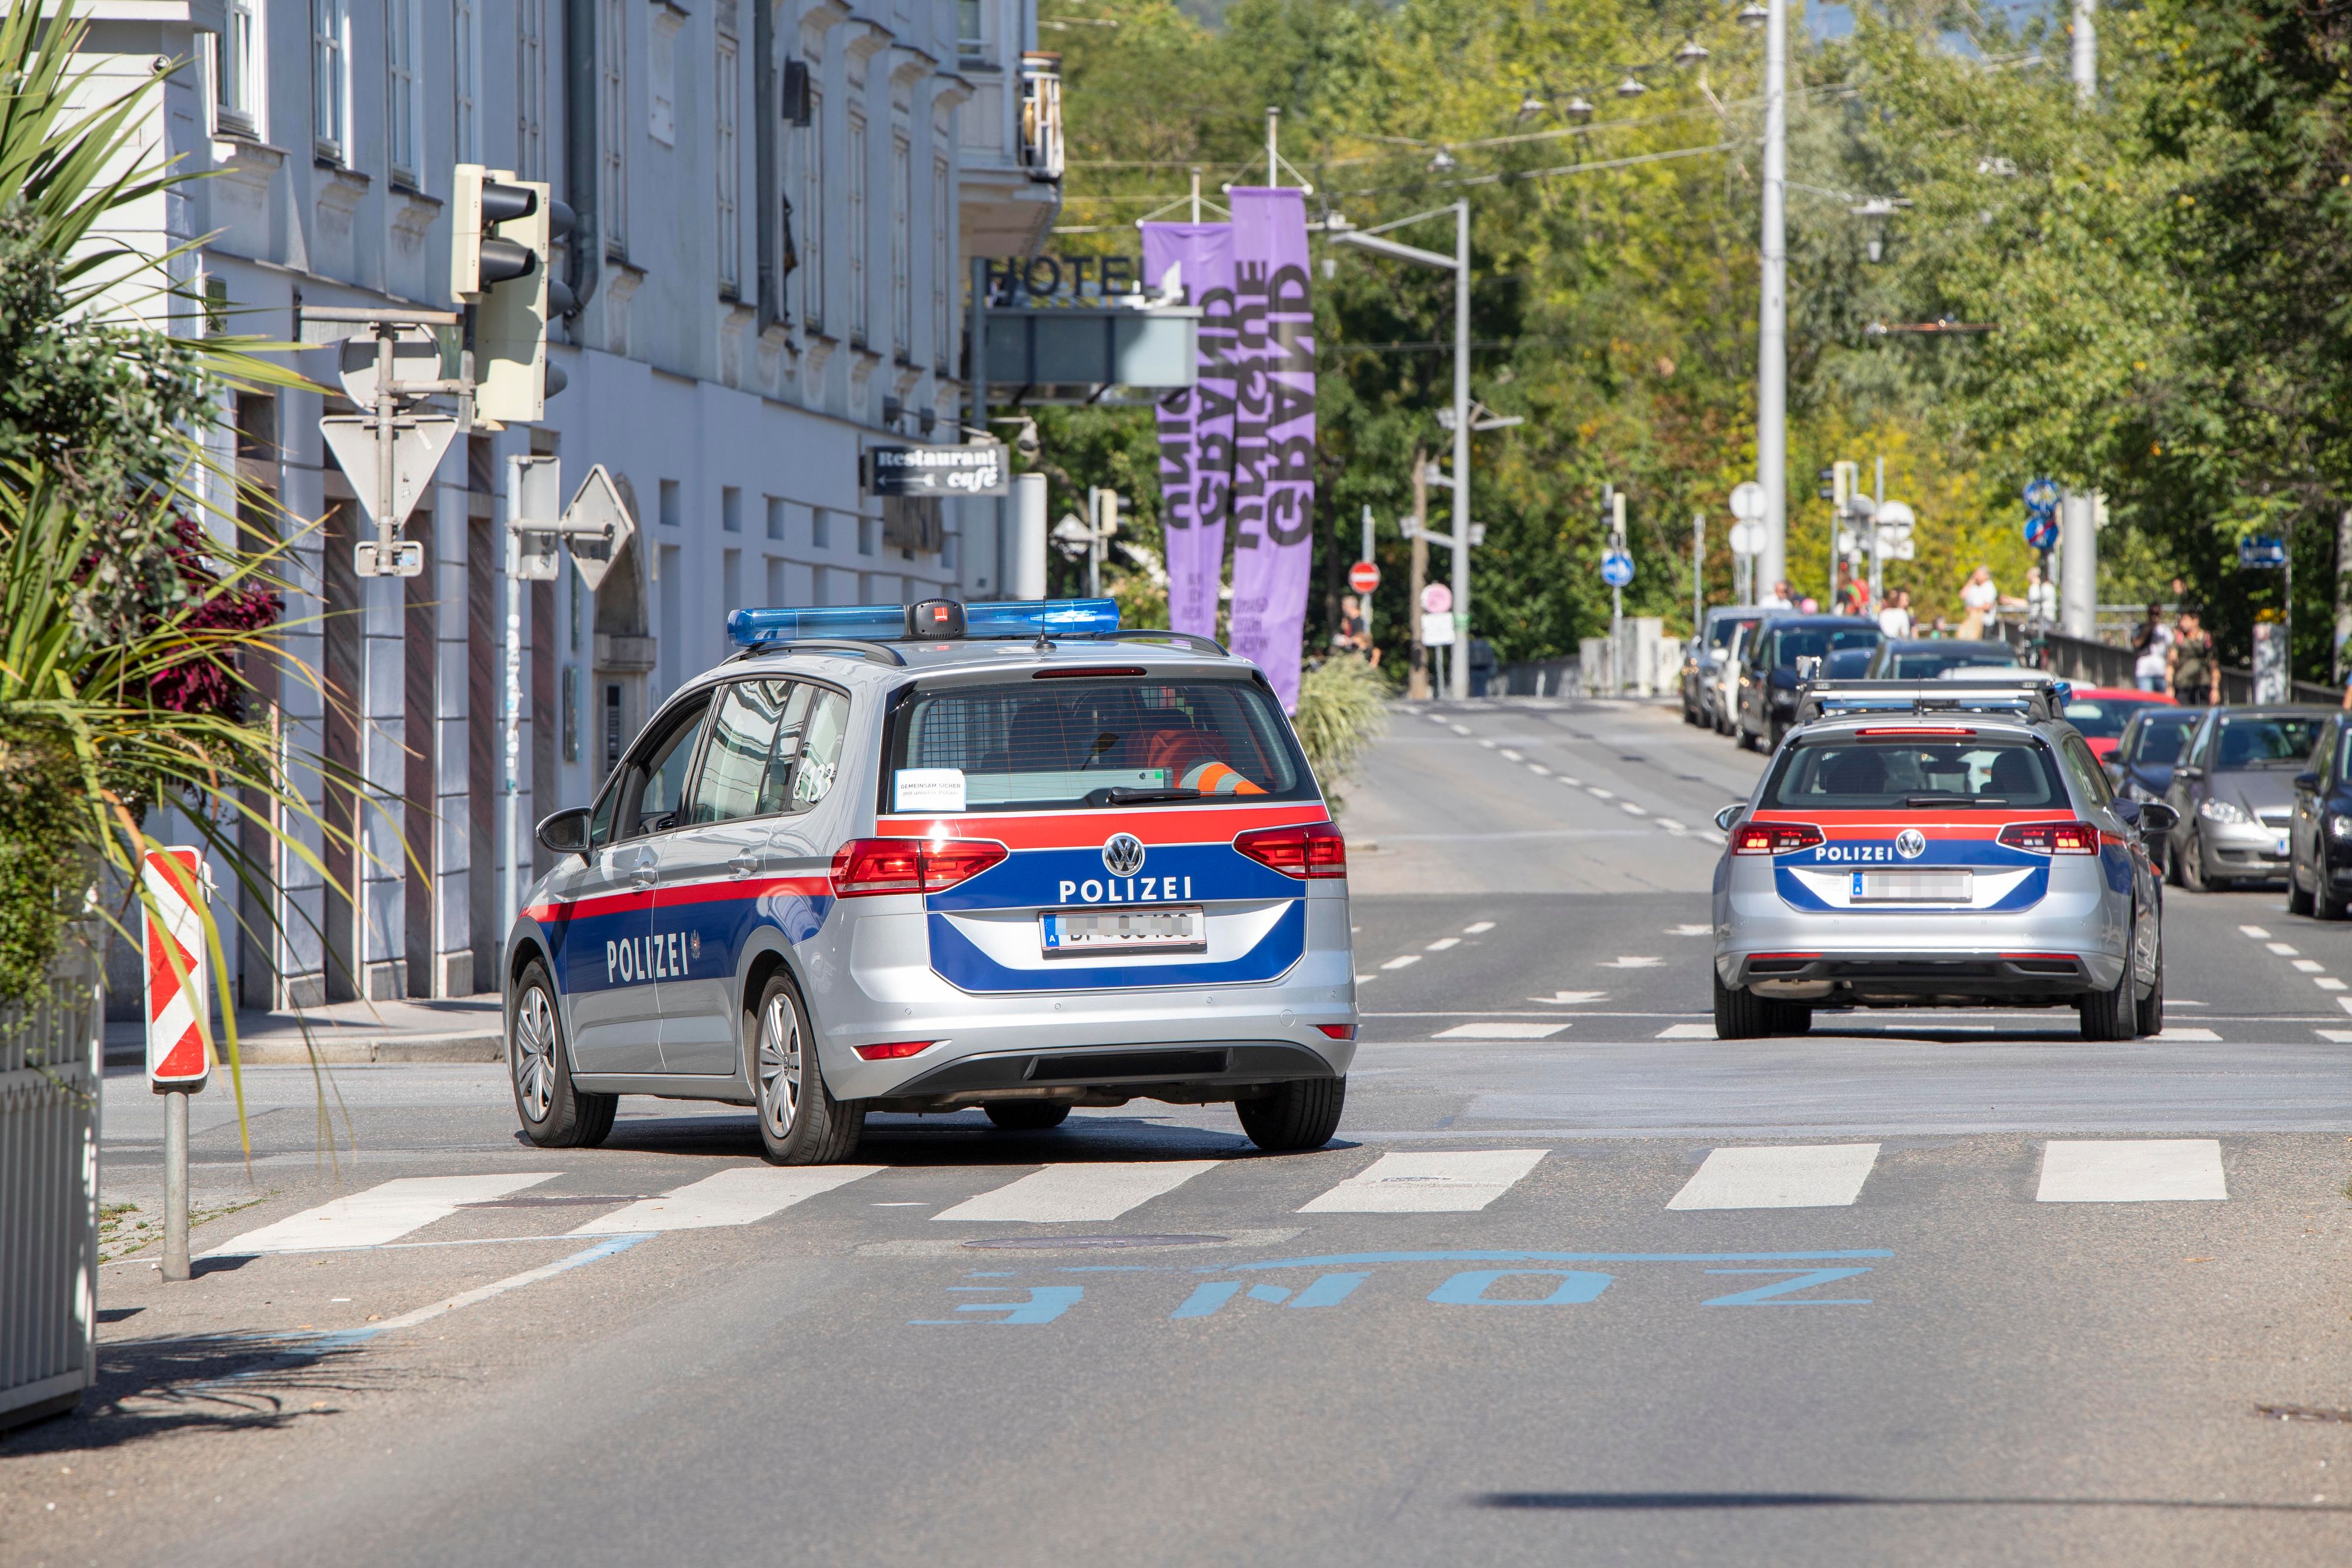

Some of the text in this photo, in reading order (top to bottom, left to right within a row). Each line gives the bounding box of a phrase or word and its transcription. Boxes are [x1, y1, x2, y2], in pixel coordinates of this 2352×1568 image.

[986, 256, 1163, 297] HOTEL
[877, 449, 997, 466] Restaurant
[947, 466, 998, 493] café
[806, 762, 835, 802] 133
[1815, 847, 1893, 861] POLIZEI
[1060, 876, 1192, 904] POLIZEI
[607, 932, 689, 983] POLIZEI
[908, 1266, 1874, 1325] ZONE
